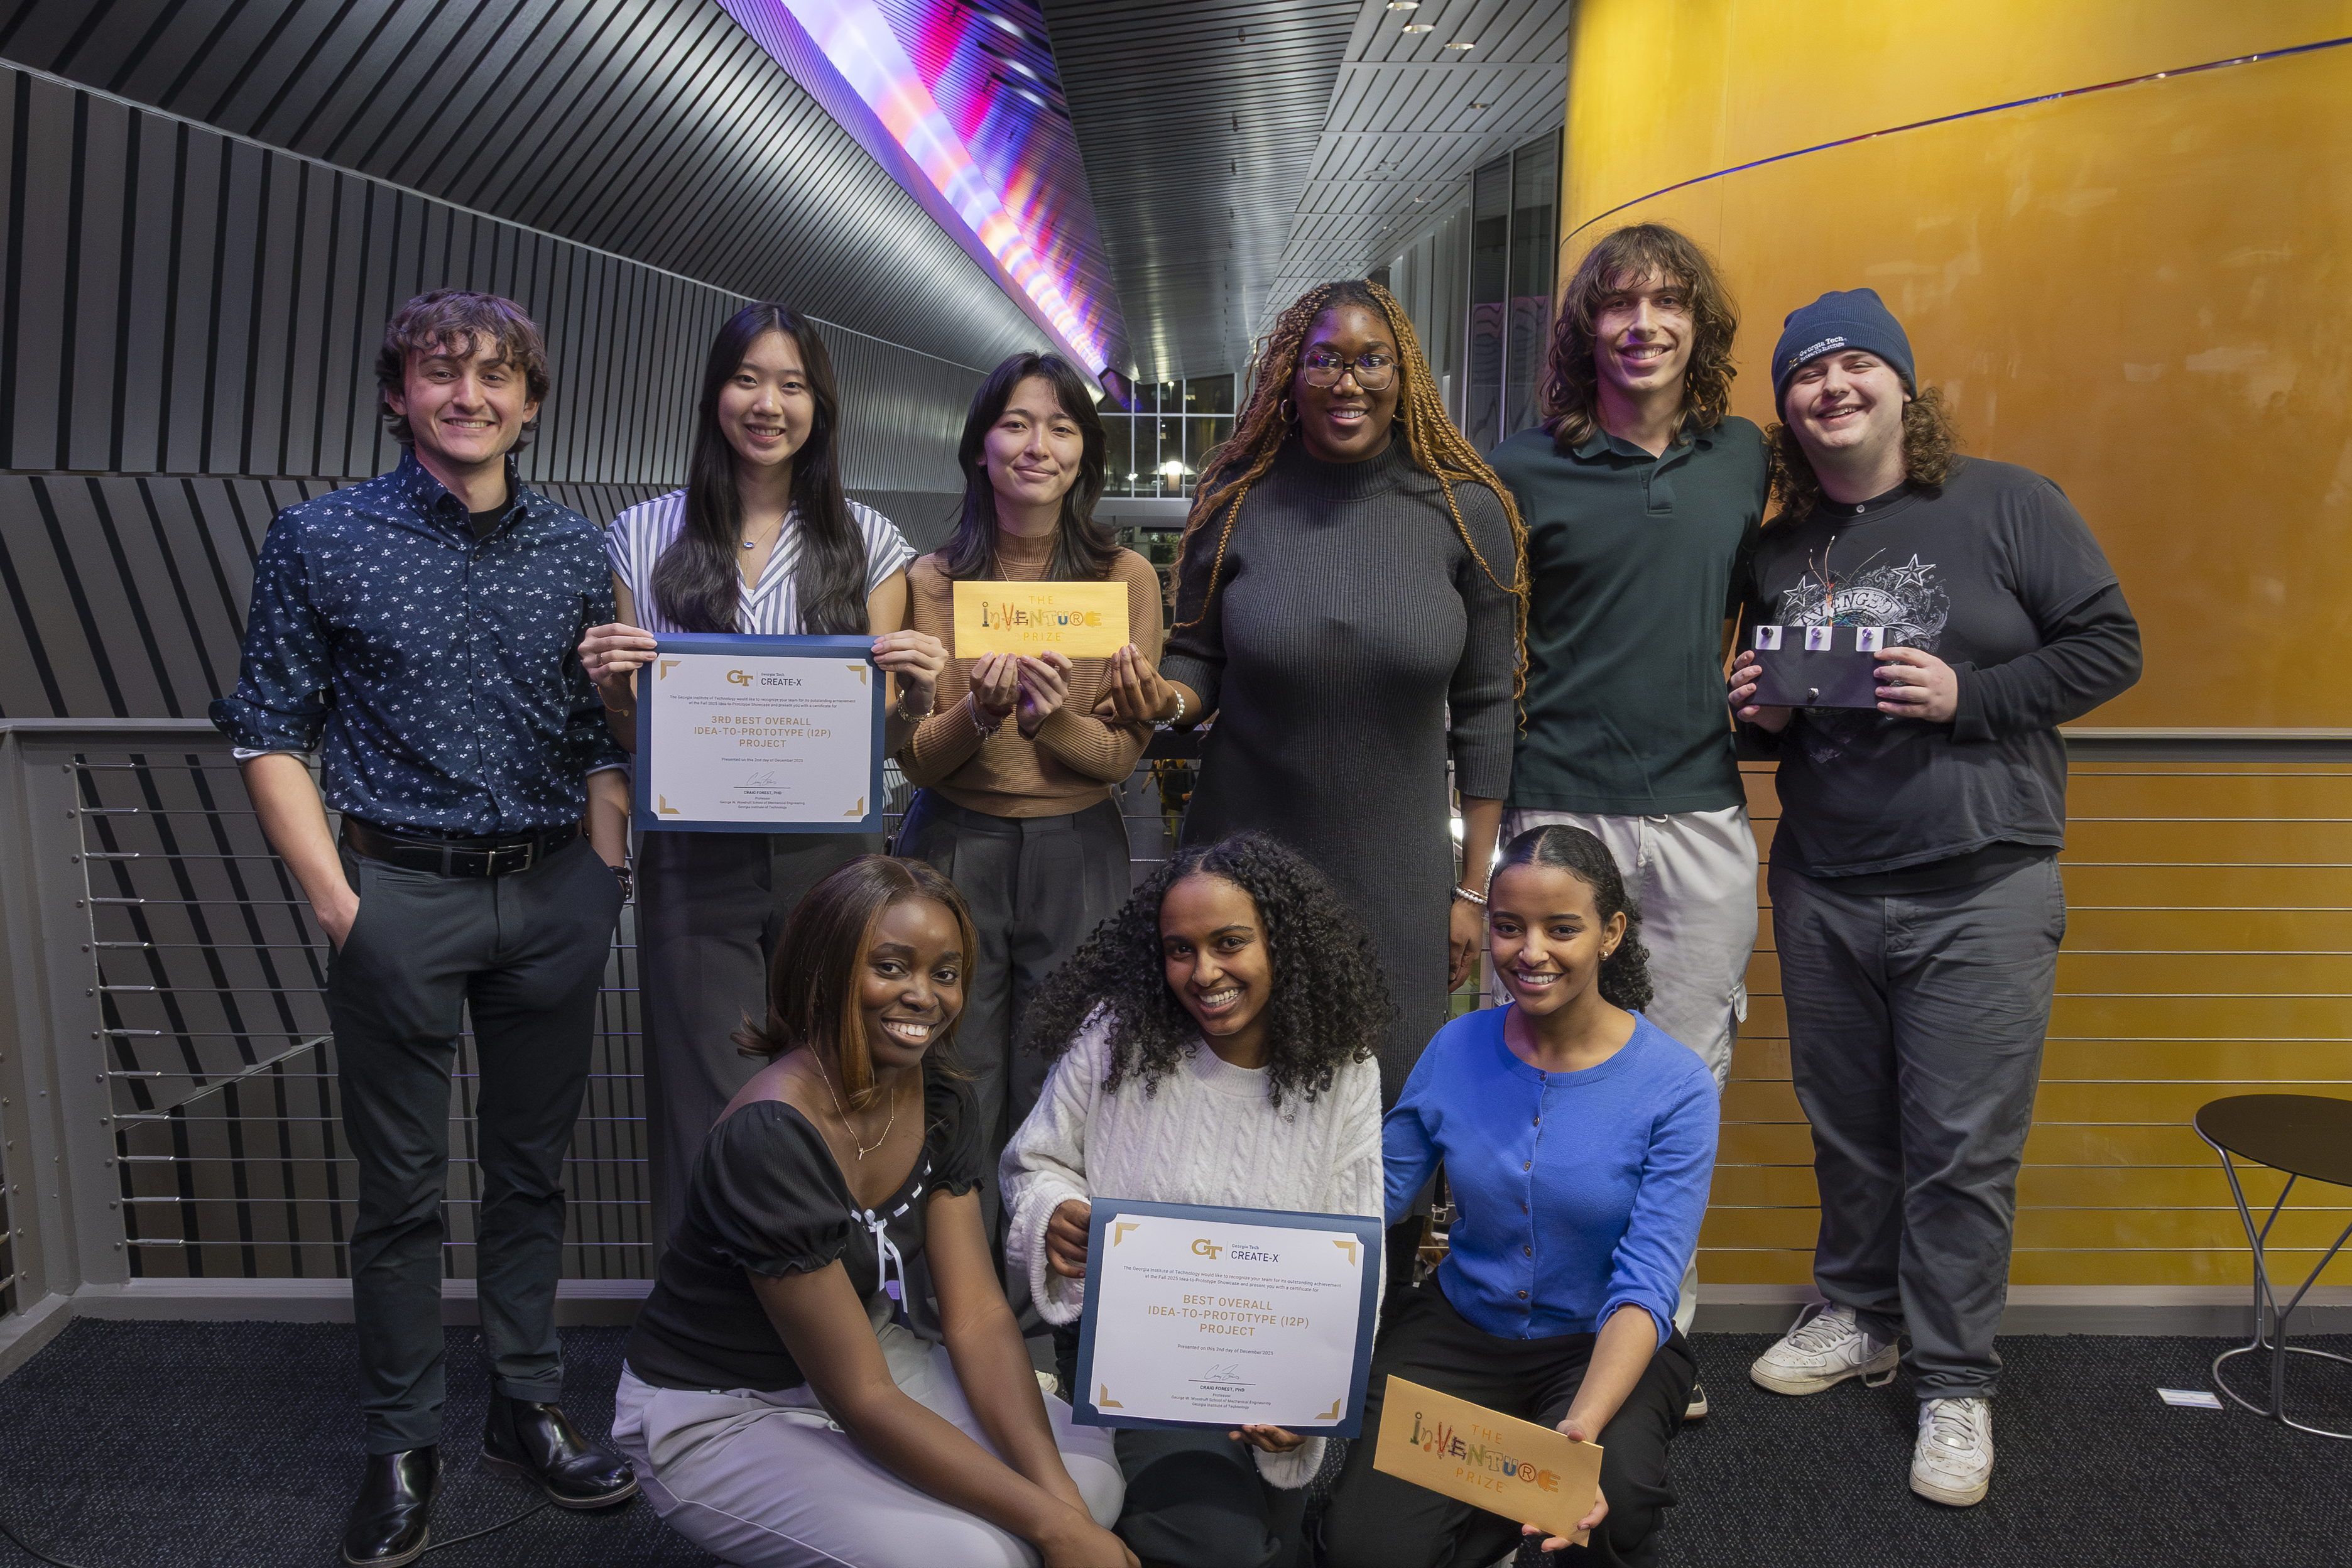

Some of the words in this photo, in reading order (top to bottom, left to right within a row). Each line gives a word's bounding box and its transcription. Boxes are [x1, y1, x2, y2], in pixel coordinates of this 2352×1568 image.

[1028, 596, 1054, 605] THE
[1023, 632, 1062, 641] PRIZE
[727, 670, 753, 687] GT
[711, 716, 731, 724] 3RD
[735, 716, 761, 724] BEST
[765, 717, 811, 726] OVERALL
[694, 727, 803, 737] IDEA-TO-PROTOTYPE
[807, 729, 831, 739] (I2P)
[739, 739, 787, 748] PROJECT
[1191, 1238, 1222, 1260] GT
[1231, 1250, 1279, 1263] CREATE-X
[1183, 1294, 1214, 1305] BEST
[1218, 1297, 1273, 1311] OVERALL
[1148, 1305, 1277, 1325] IDEA-TO-PROTOTYPE
[1280, 1315, 1309, 1329] (I2P)
[1200, 1323, 1256, 1337] PROJECT
[1471, 1424, 1503, 1445] THE
[1456, 1467, 1508, 1494] PRIZE
